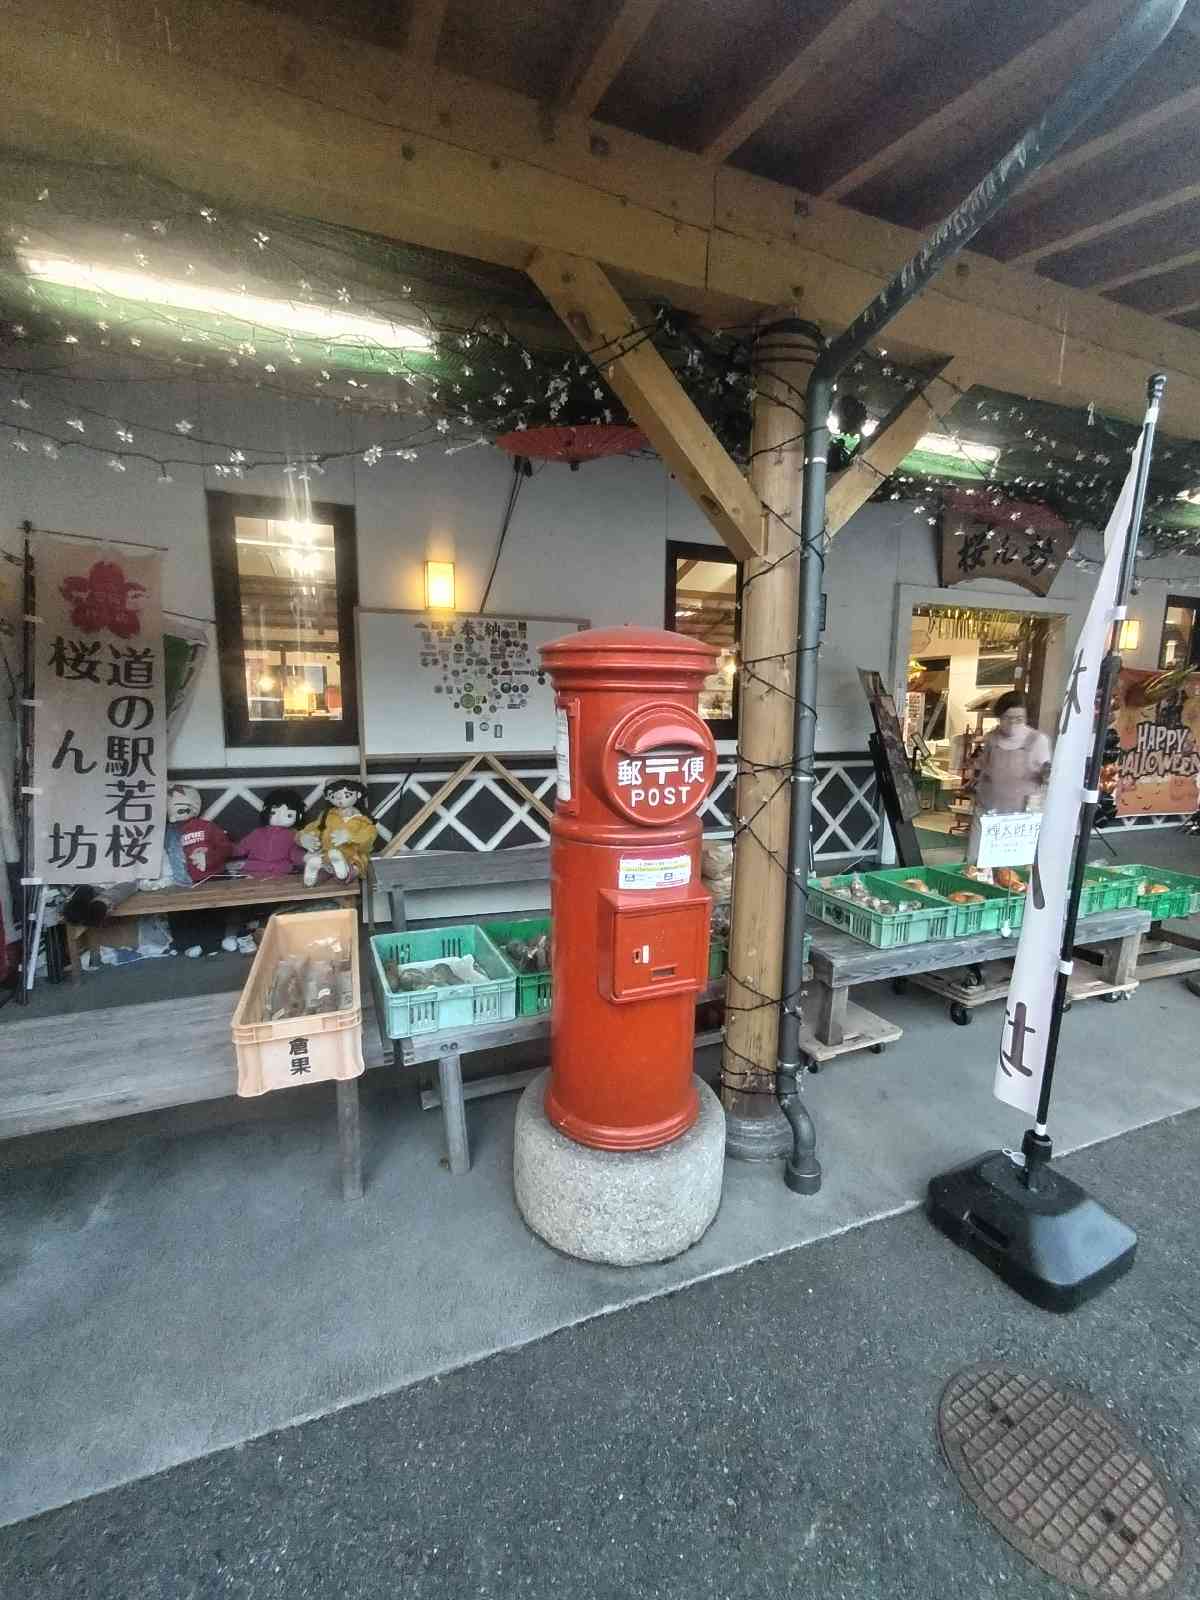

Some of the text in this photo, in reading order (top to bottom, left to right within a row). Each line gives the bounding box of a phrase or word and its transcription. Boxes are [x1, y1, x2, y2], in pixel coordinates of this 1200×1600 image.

[48, 637, 102, 869] 桜ん坊
[105, 644, 156, 869] 道の駅若桜
[631, 786, 691, 807] POST
[1137, 723, 1188, 753] HAPPY
